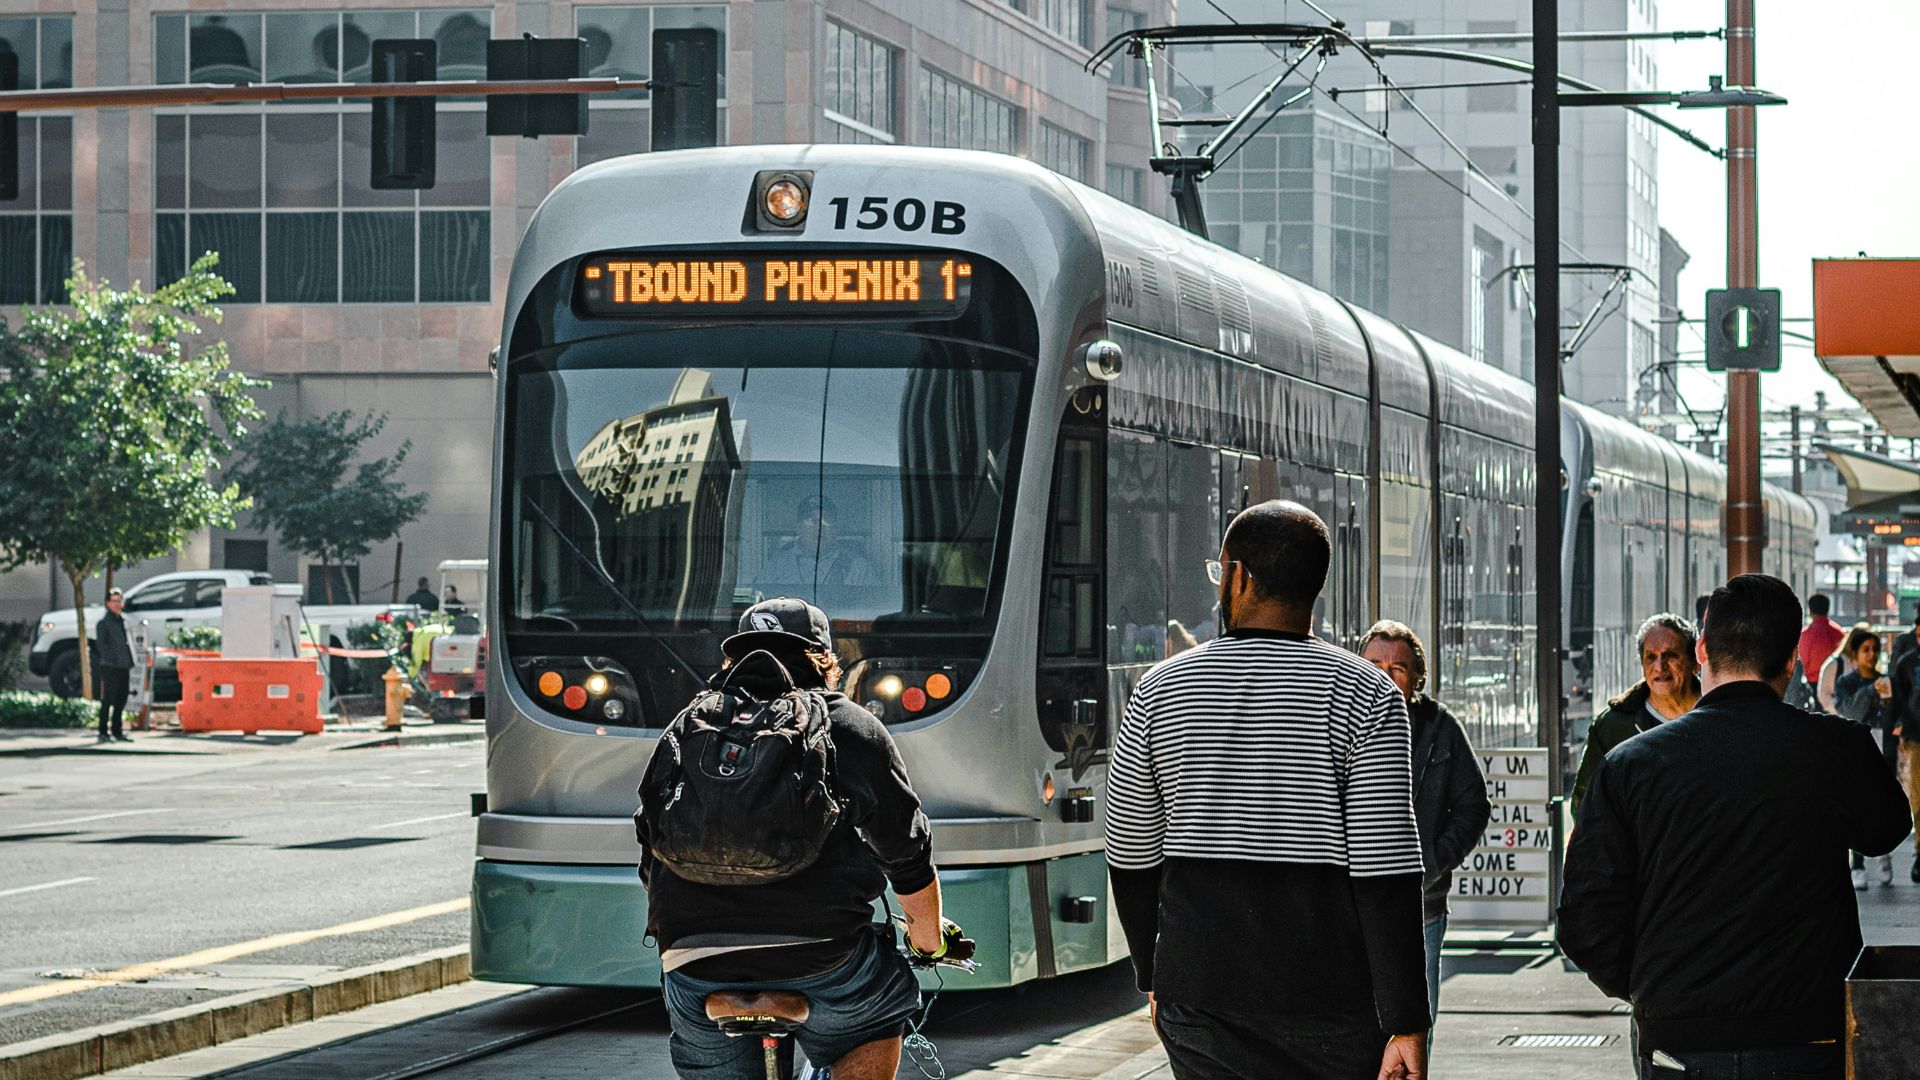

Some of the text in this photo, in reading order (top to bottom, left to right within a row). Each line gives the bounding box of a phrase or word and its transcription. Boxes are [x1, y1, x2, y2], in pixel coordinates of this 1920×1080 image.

[829, 196, 967, 235] 150B
[608, 261, 747, 303] TBOUND
[765, 260, 920, 302] PHOENIX
[1109, 261, 1133, 308] 150B
[1459, 877, 1524, 896] ENJOY
